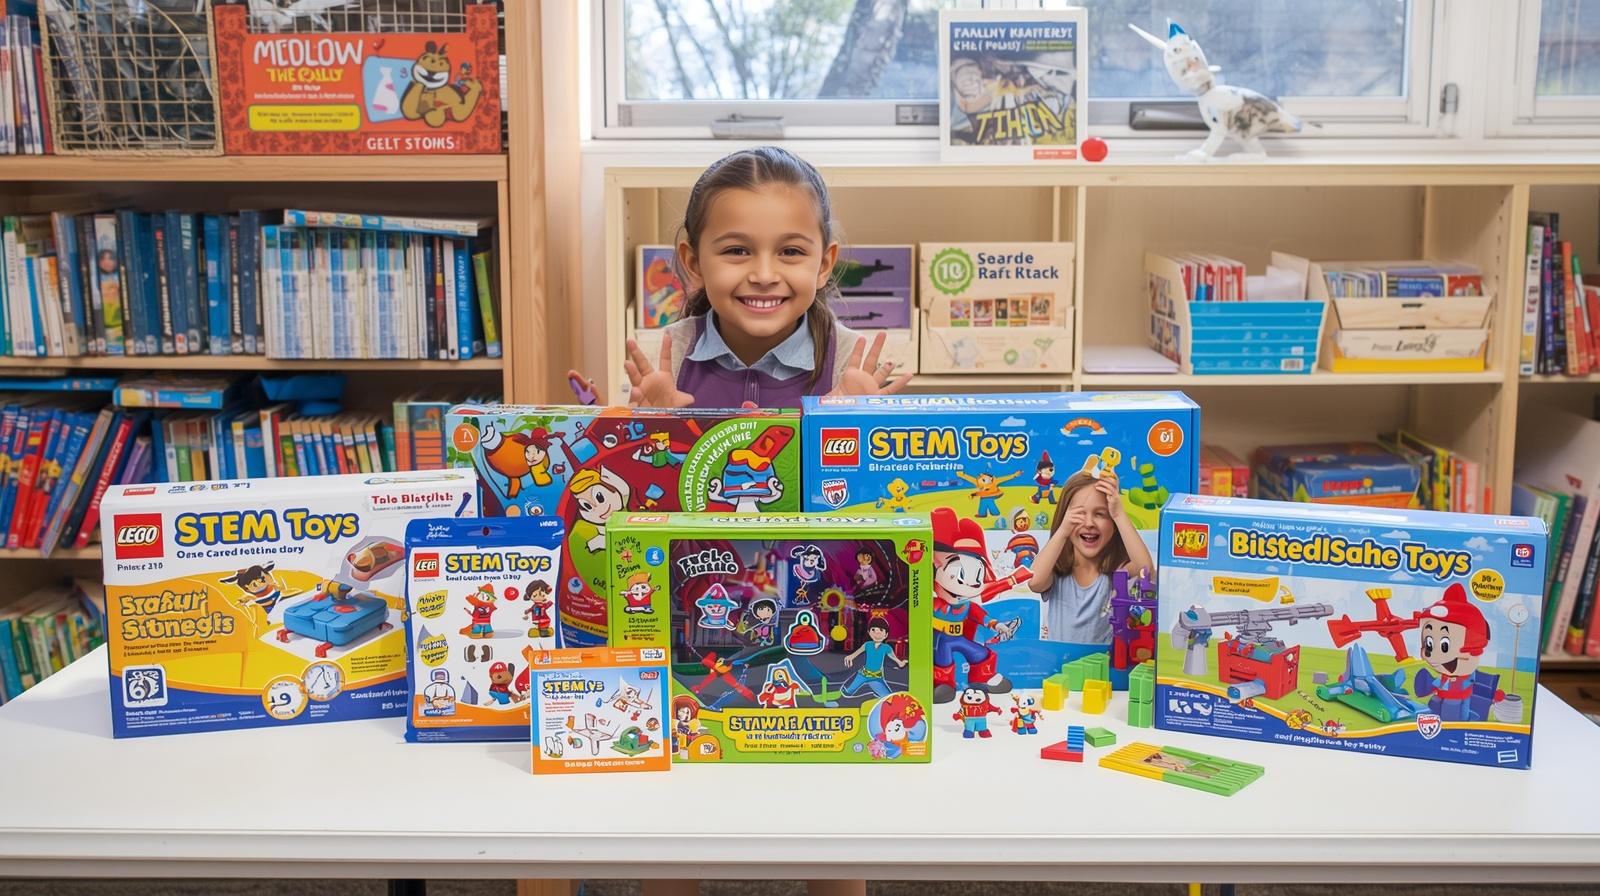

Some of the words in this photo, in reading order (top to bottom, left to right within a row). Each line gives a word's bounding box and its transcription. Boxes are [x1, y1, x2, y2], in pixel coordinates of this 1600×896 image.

[367, 137, 401, 150] GELT
[869, 427, 960, 461] STEM
[962, 427, 1030, 463] Toys
[117, 525, 160, 546] LEGO
[175, 510, 280, 547] STEM
[282, 508, 359, 543] Toys
[446, 552, 503, 573] STEM
[505, 552, 552, 575] Toys
[1400, 541, 1473, 581] Toys
